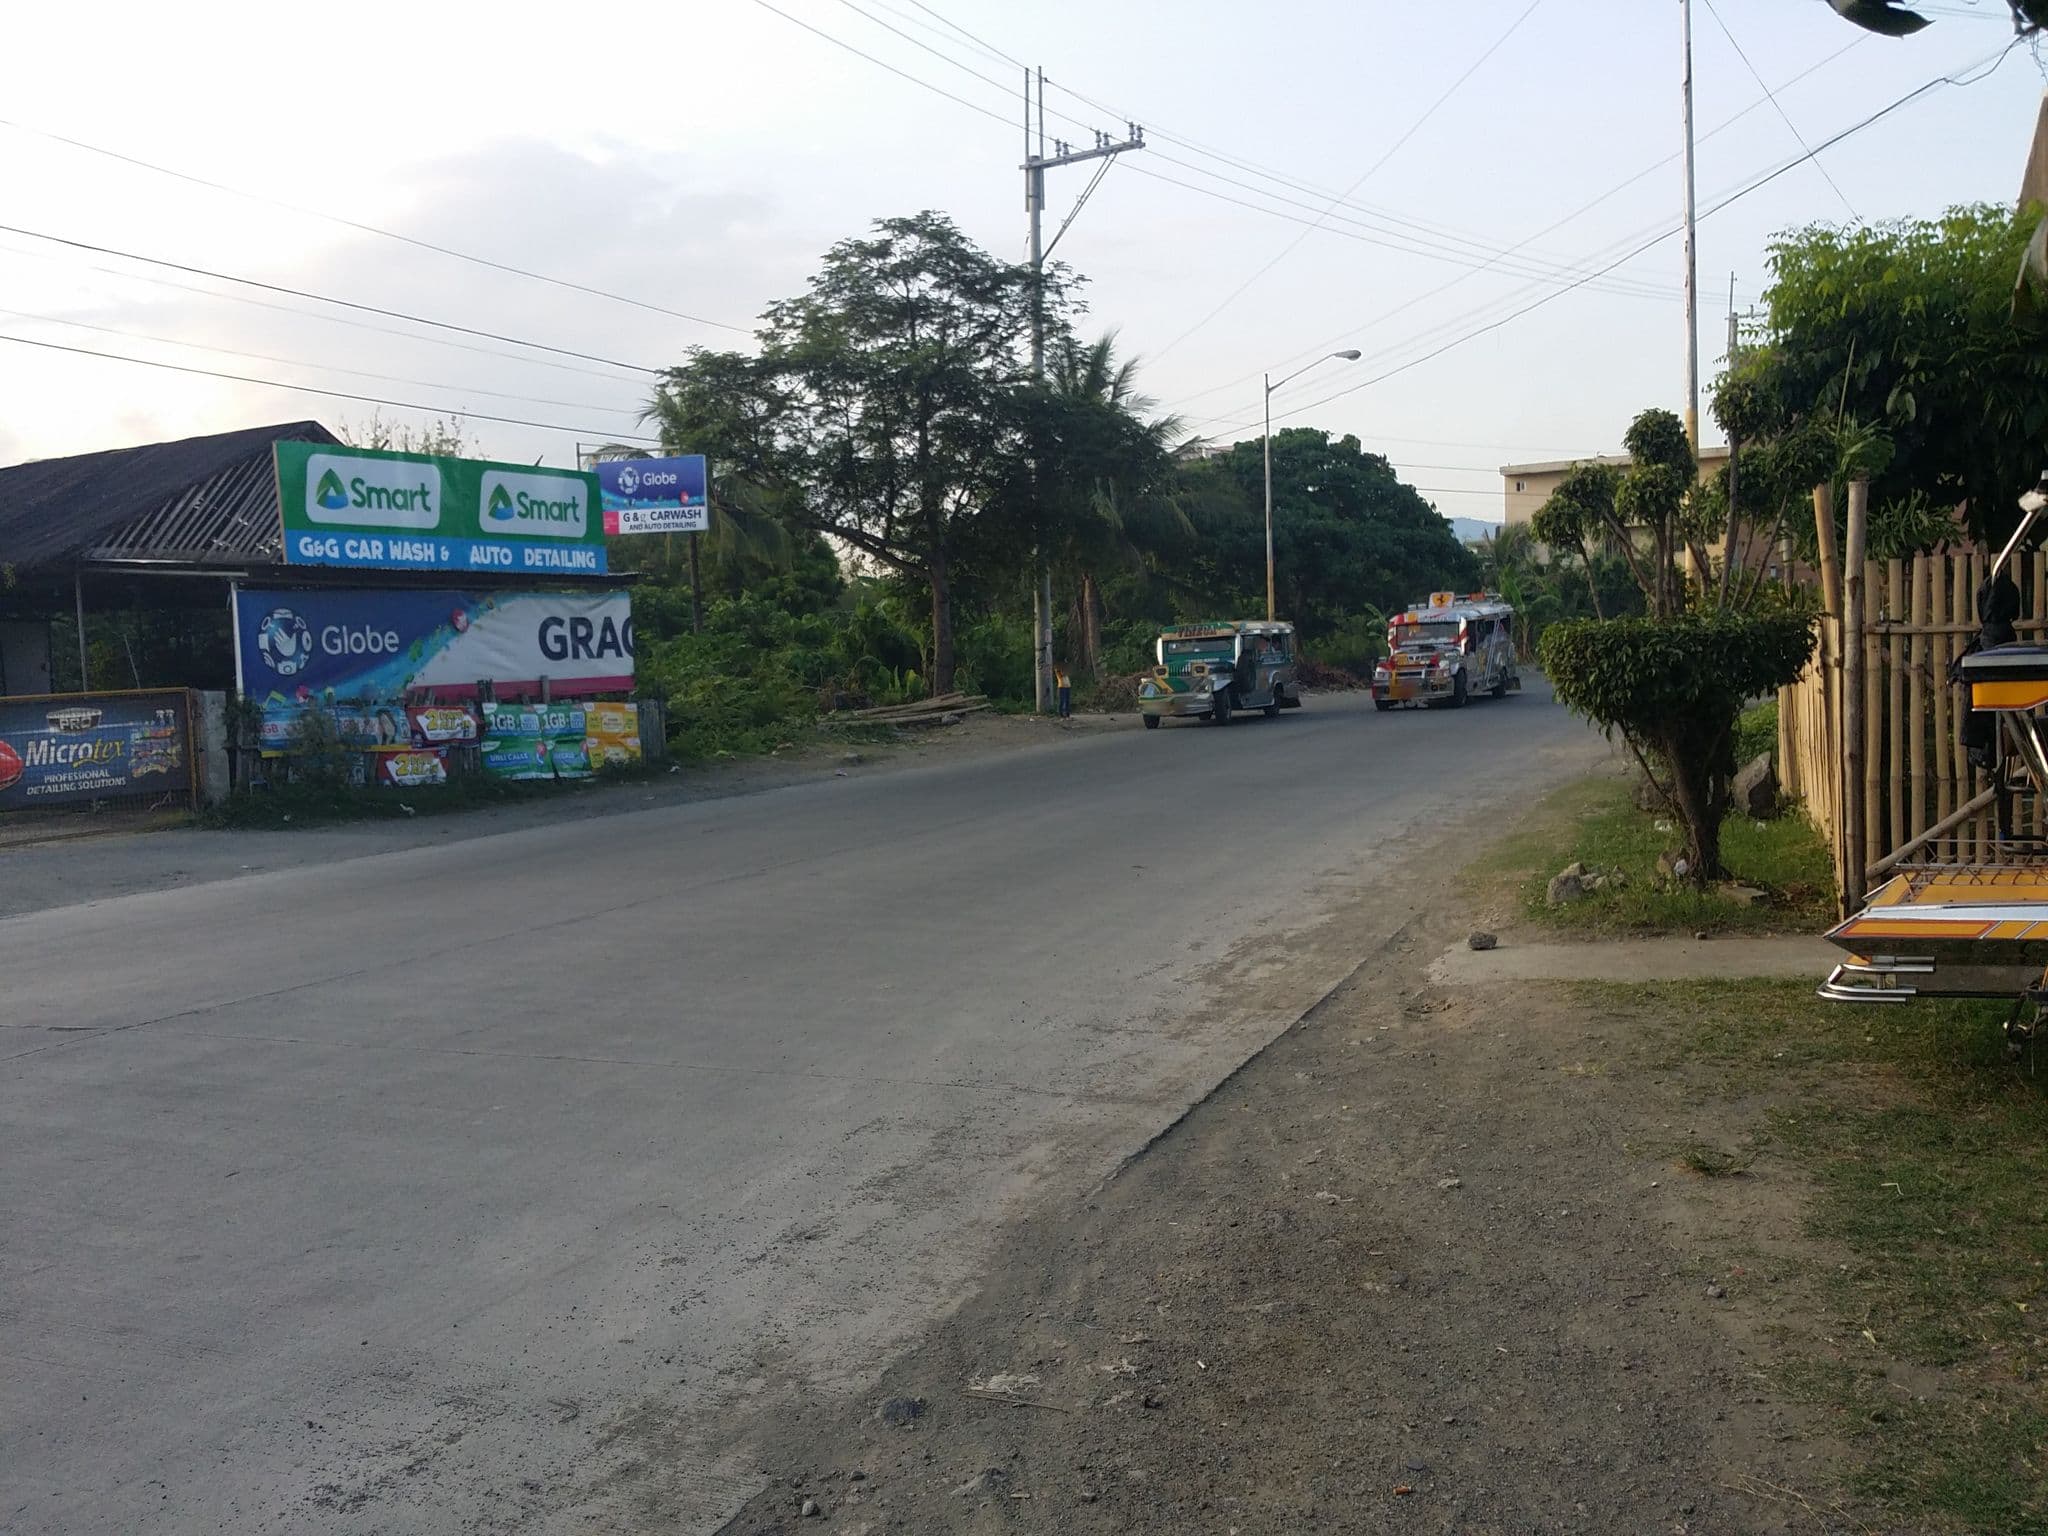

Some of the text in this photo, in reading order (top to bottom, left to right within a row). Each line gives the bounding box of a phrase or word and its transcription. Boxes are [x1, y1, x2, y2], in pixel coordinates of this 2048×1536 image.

[643, 471, 677, 486] Globe
[350, 477, 432, 513] Smart
[516, 491, 580, 524] Smart
[623, 513, 630, 523] G
[632, 512, 639, 521] &
[650, 509, 702, 521] CARWASH
[629, 521, 697, 531] AND AUTO DETAILING
[299, 537, 596, 569] G&G CAR WASH & AUTO DETAILING
[321, 625, 400, 656] Globe
[59, 716, 92, 730] PRO
[25, 737, 125, 768] Microtex
[26, 776, 126, 796] DETAILING SOLUTIONS
[44, 769, 110, 784] PROFESSIONAL
